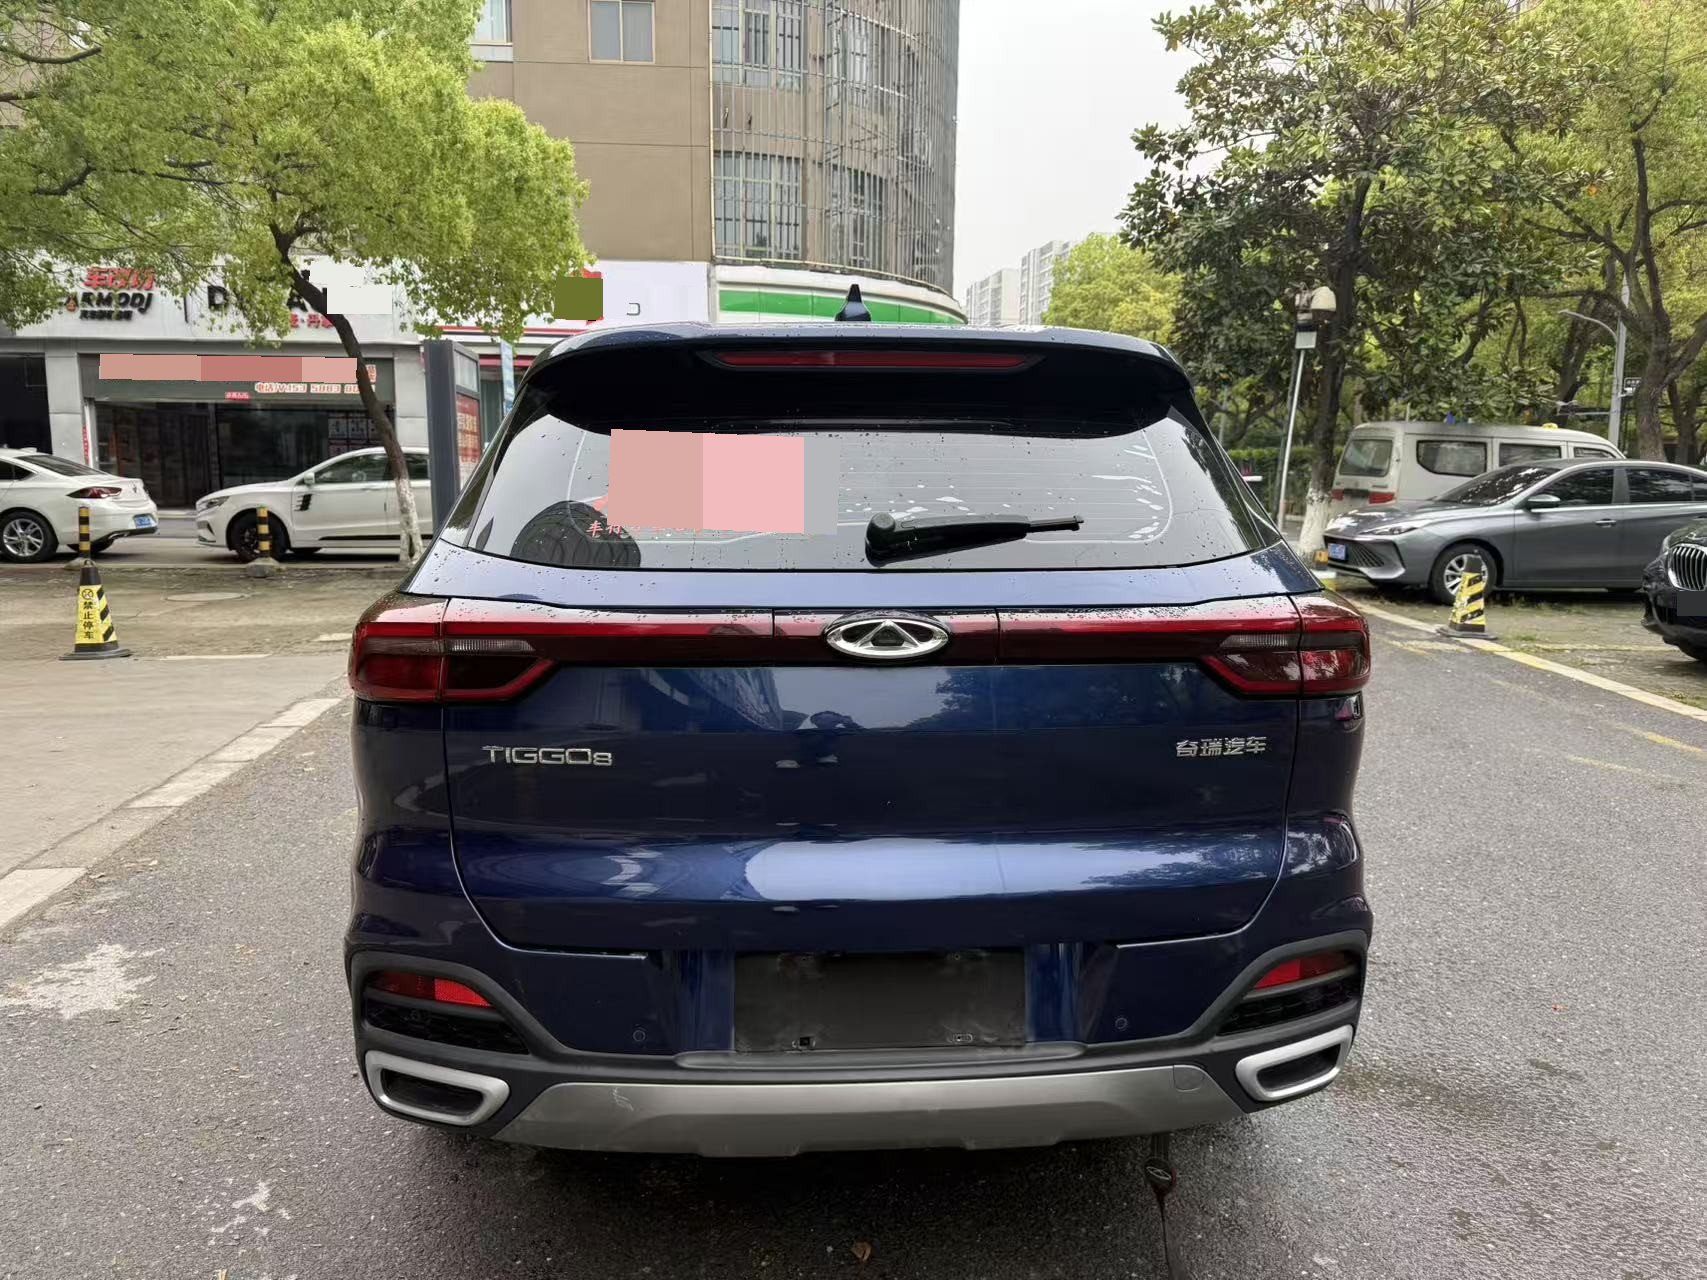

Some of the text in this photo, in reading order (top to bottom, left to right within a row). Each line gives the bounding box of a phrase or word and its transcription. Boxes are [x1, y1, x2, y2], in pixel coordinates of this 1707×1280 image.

[82, 601, 95, 639] 禁止停车
[1176, 736, 1267, 757] 奇瑞汽车
